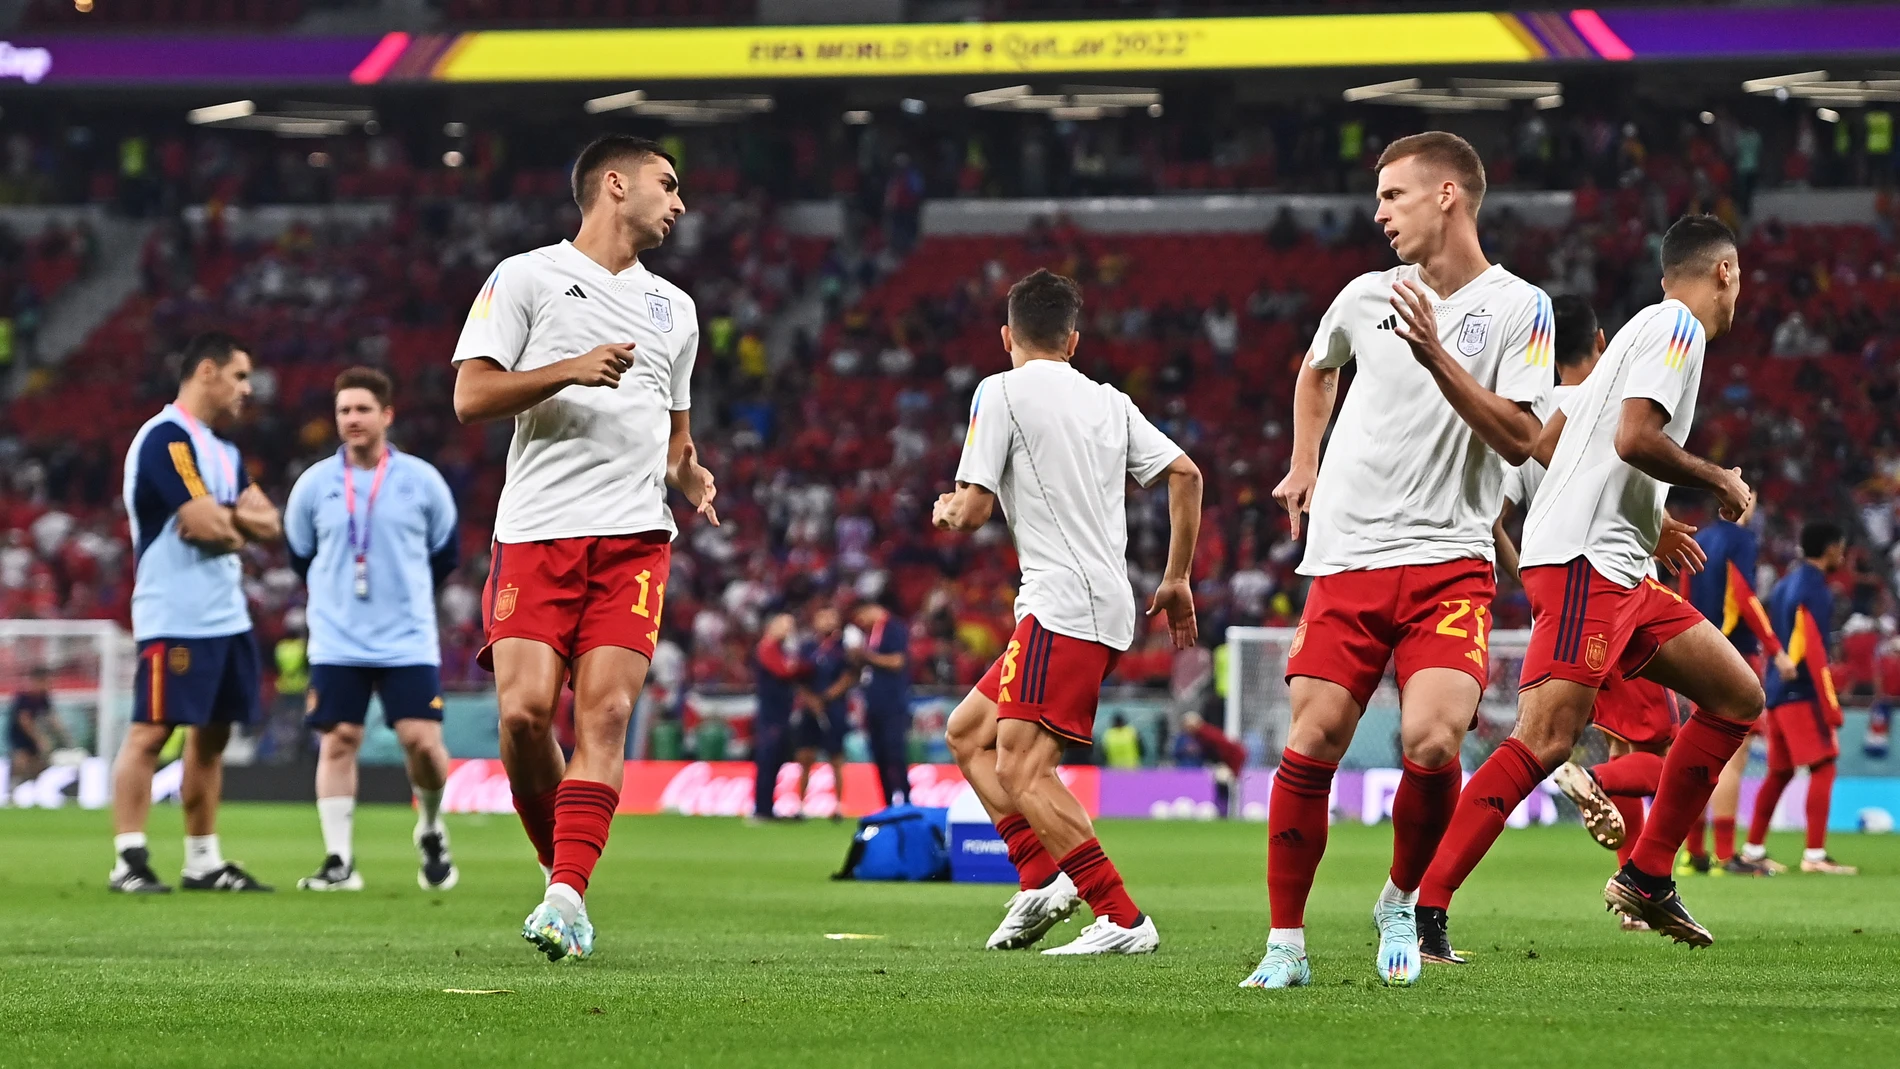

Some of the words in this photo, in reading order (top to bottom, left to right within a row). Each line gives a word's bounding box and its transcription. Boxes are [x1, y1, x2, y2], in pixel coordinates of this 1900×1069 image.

[749, 37, 805, 61] FIFA
[816, 36, 910, 61] WORLD
[915, 35, 970, 60] CUP
[631, 569, 664, 629] 11
[1436, 599, 1487, 652] 21
